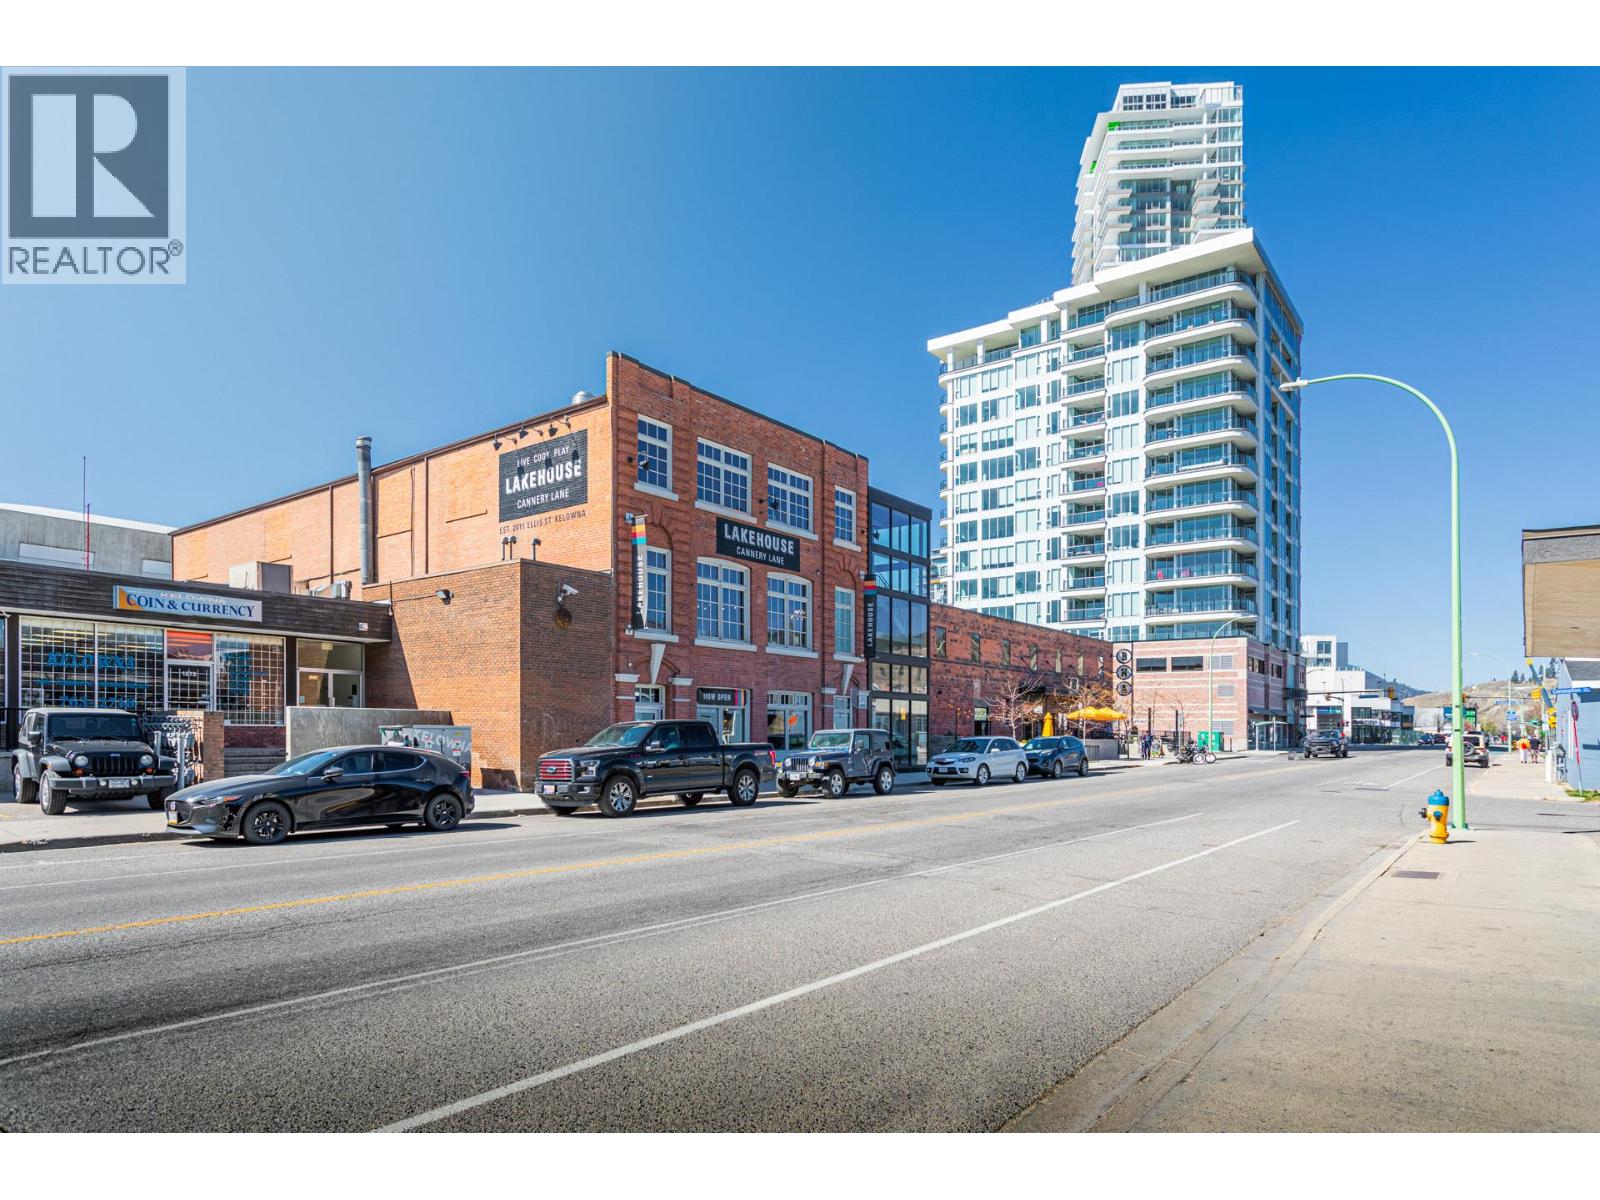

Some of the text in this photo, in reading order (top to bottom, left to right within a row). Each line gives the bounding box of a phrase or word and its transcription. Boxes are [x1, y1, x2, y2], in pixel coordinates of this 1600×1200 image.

[553, 446, 570, 457] PLAY
[505, 458, 582, 494] LAKEHOUSE
[517, 488, 570, 509] CANNERY LANE
[526, 520, 543, 529] ELLIS
[555, 510, 586, 522] KELOWNA
[724, 522, 795, 556] LAKEHOUSE
[736, 546, 785, 566] CANNERY LANE
[636, 554, 644, 615] LAKEHOUSE
[126, 593, 255, 618] COIN & CURRENCY
[159, 592, 227, 604] KELOWNA
[703, 692, 732, 701] NOW OPEN
